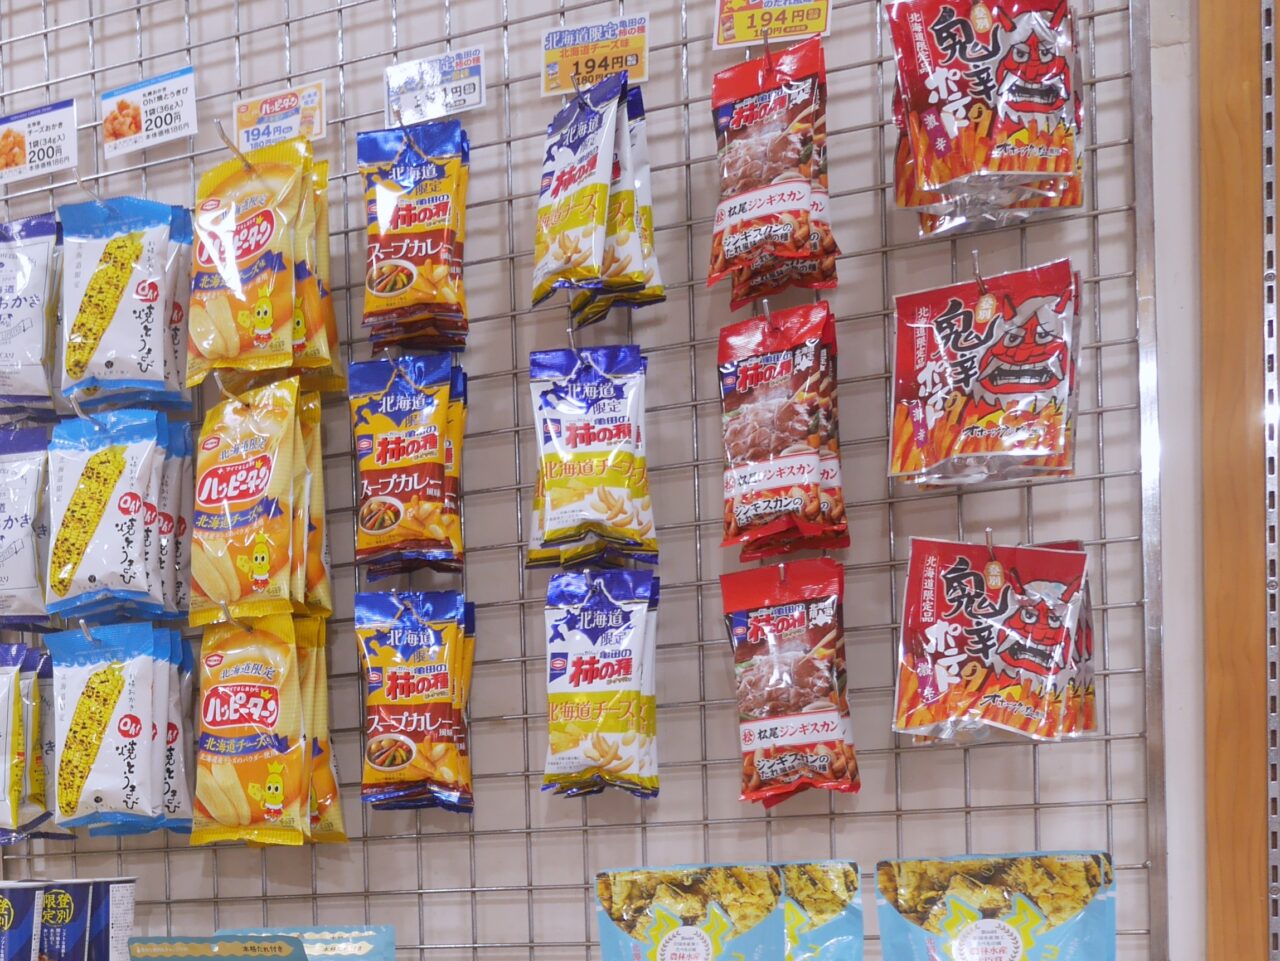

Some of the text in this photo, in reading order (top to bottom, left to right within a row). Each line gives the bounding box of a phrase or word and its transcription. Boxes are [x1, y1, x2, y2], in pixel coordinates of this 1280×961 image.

[544, 21, 618, 50] 北海道限定
[560, 40, 630, 59] 北海道チーズ味
[572, 55, 623, 76] 194円
[28, 122, 63, 136] チーズおかき
[144, 112, 181, 132] 200円
[29, 146, 62, 163] 200円
[552, 153, 598, 199] 柿の種
[728, 191, 805, 218] 松尾ジンギスカン
[367, 239, 453, 264] スープカレー
[133, 304, 154, 373] 焼とうきび
[565, 383, 615, 399] 北海道
[593, 401, 621, 414] 限定
[565, 423, 631, 448] 柿の種
[199, 467, 269, 501] ハッピーターン
[360, 474, 441, 500] スープカレー
[735, 497, 803, 516] ジンギスカンの
[115, 518, 136, 584] 焼とうきび
[921, 556, 937, 622] 北海道限定品
[577, 611, 622, 629] 北海道
[748, 611, 806, 643] 柿の種
[601, 633, 628, 646] 限定
[600, 650, 632, 659] 亀田の
[924, 621, 967, 692] ポテト
[220, 663, 275, 679] 北海道限定
[570, 656, 632, 687] 柿の種
[386, 672, 448, 700] 柿の種
[206, 693, 277, 725] ハッピーターン
[548, 699, 638, 722] 北海道チーズ
[367, 712, 453, 733] スープカレー
[758, 720, 838, 741] 松尾ジンギスカン
[756, 754, 829, 770] ジンギスカンの
[116, 741, 140, 809] 焼とうきび
